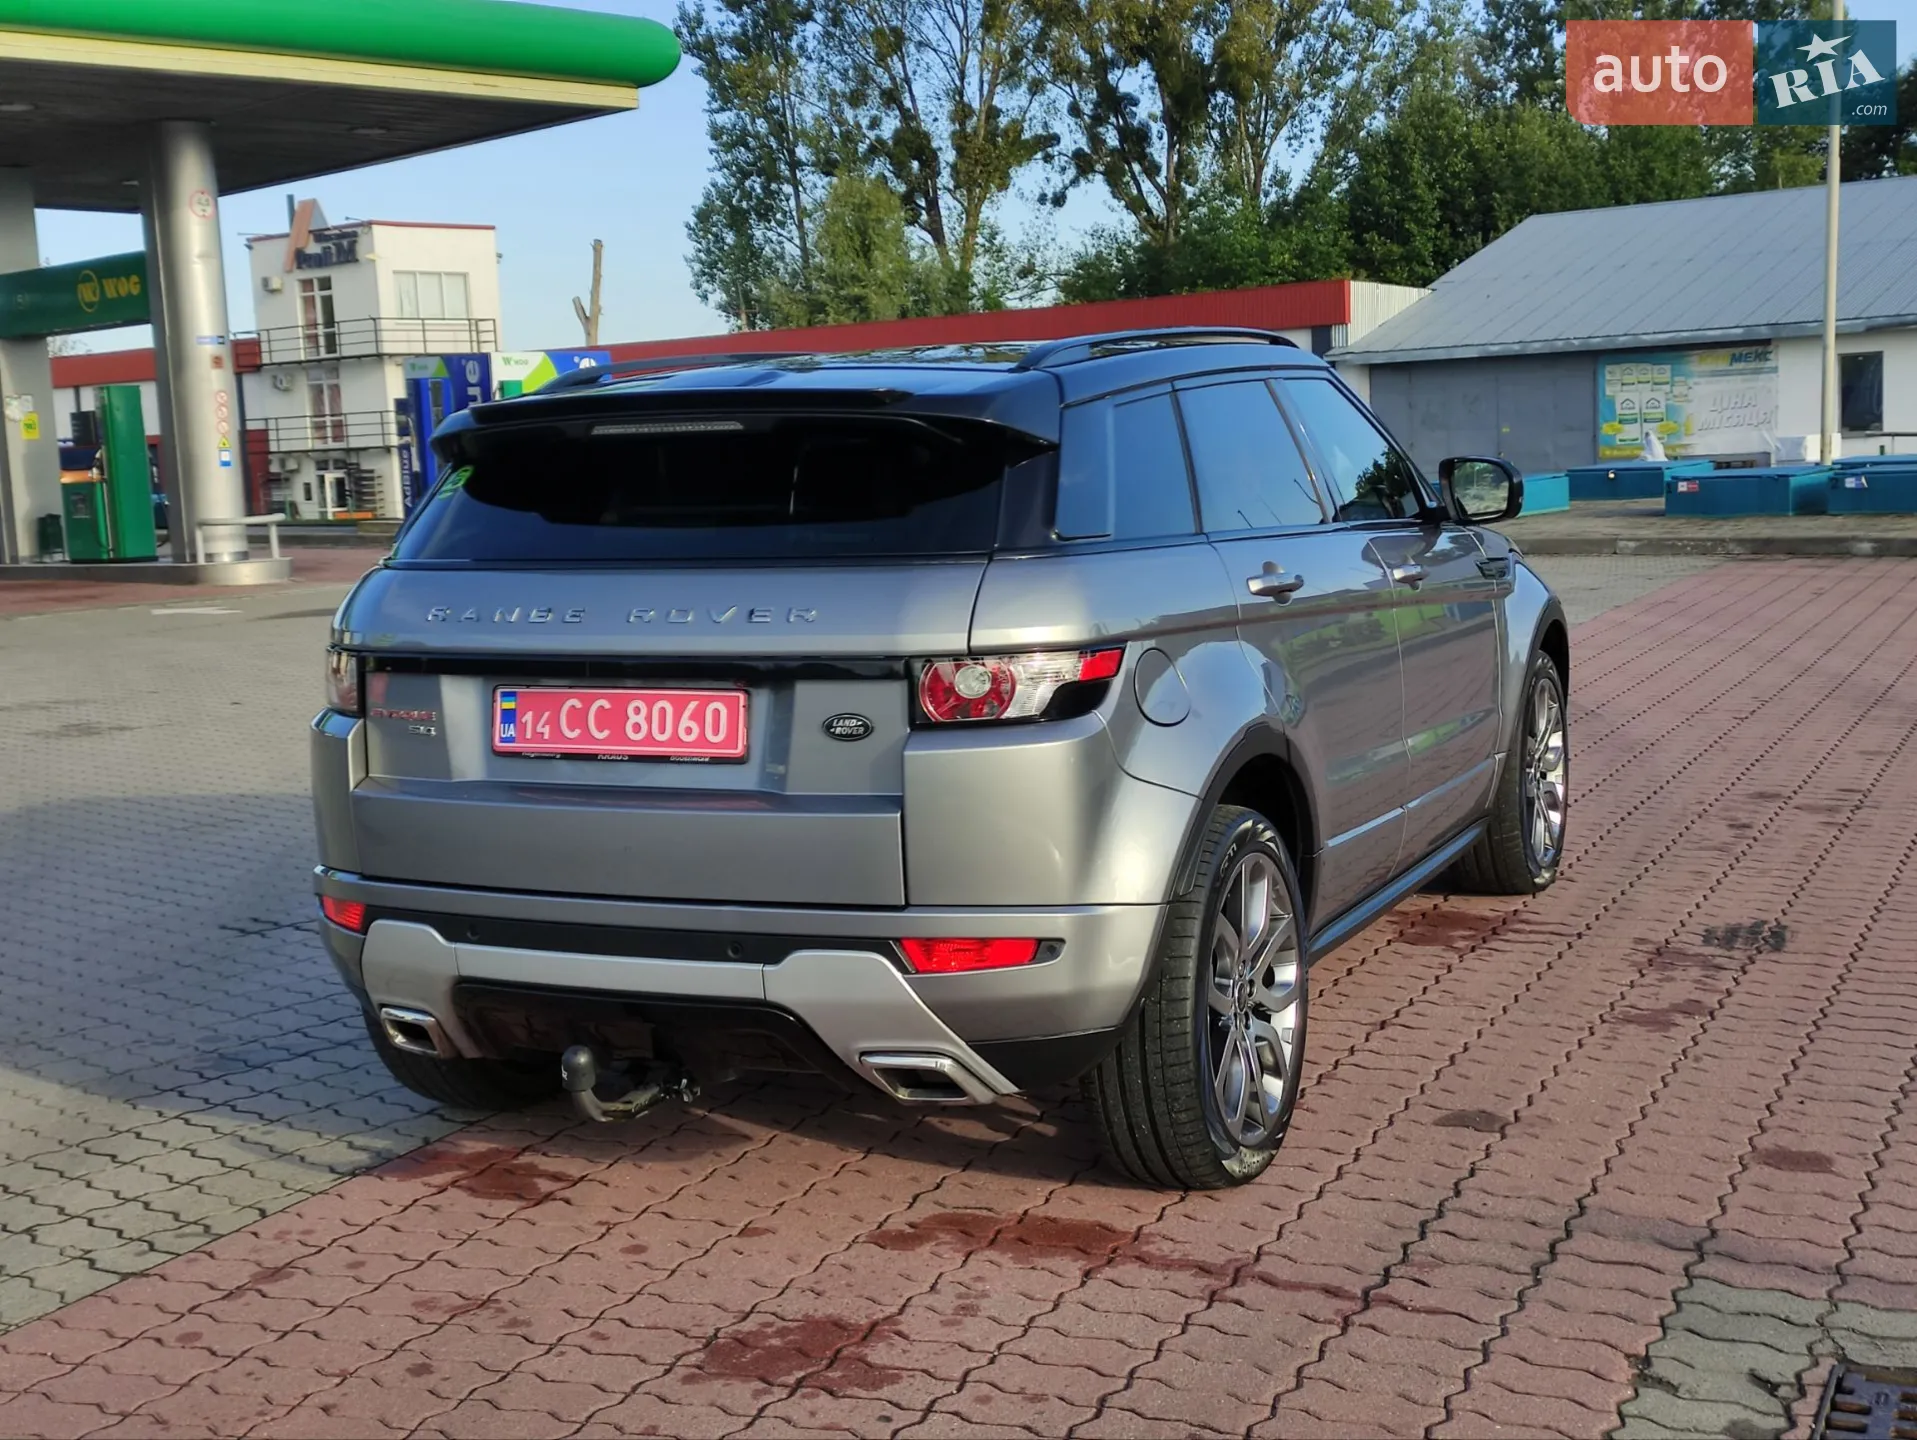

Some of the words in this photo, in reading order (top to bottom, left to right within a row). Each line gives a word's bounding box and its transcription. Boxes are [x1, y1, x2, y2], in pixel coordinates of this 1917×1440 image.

[102, 274, 140, 299] WOG
[401, 449, 413, 508] AdBlue
[426, 606, 587, 624] RANGE
[625, 605, 818, 624] ROVER
[500, 723, 516, 738] UA
[521, 710, 550, 740] 14
[559, 698, 612, 739] CC
[624, 699, 728, 744] 8060
[832, 719, 858, 727] LAND
[834, 726, 865, 735] ROVER
